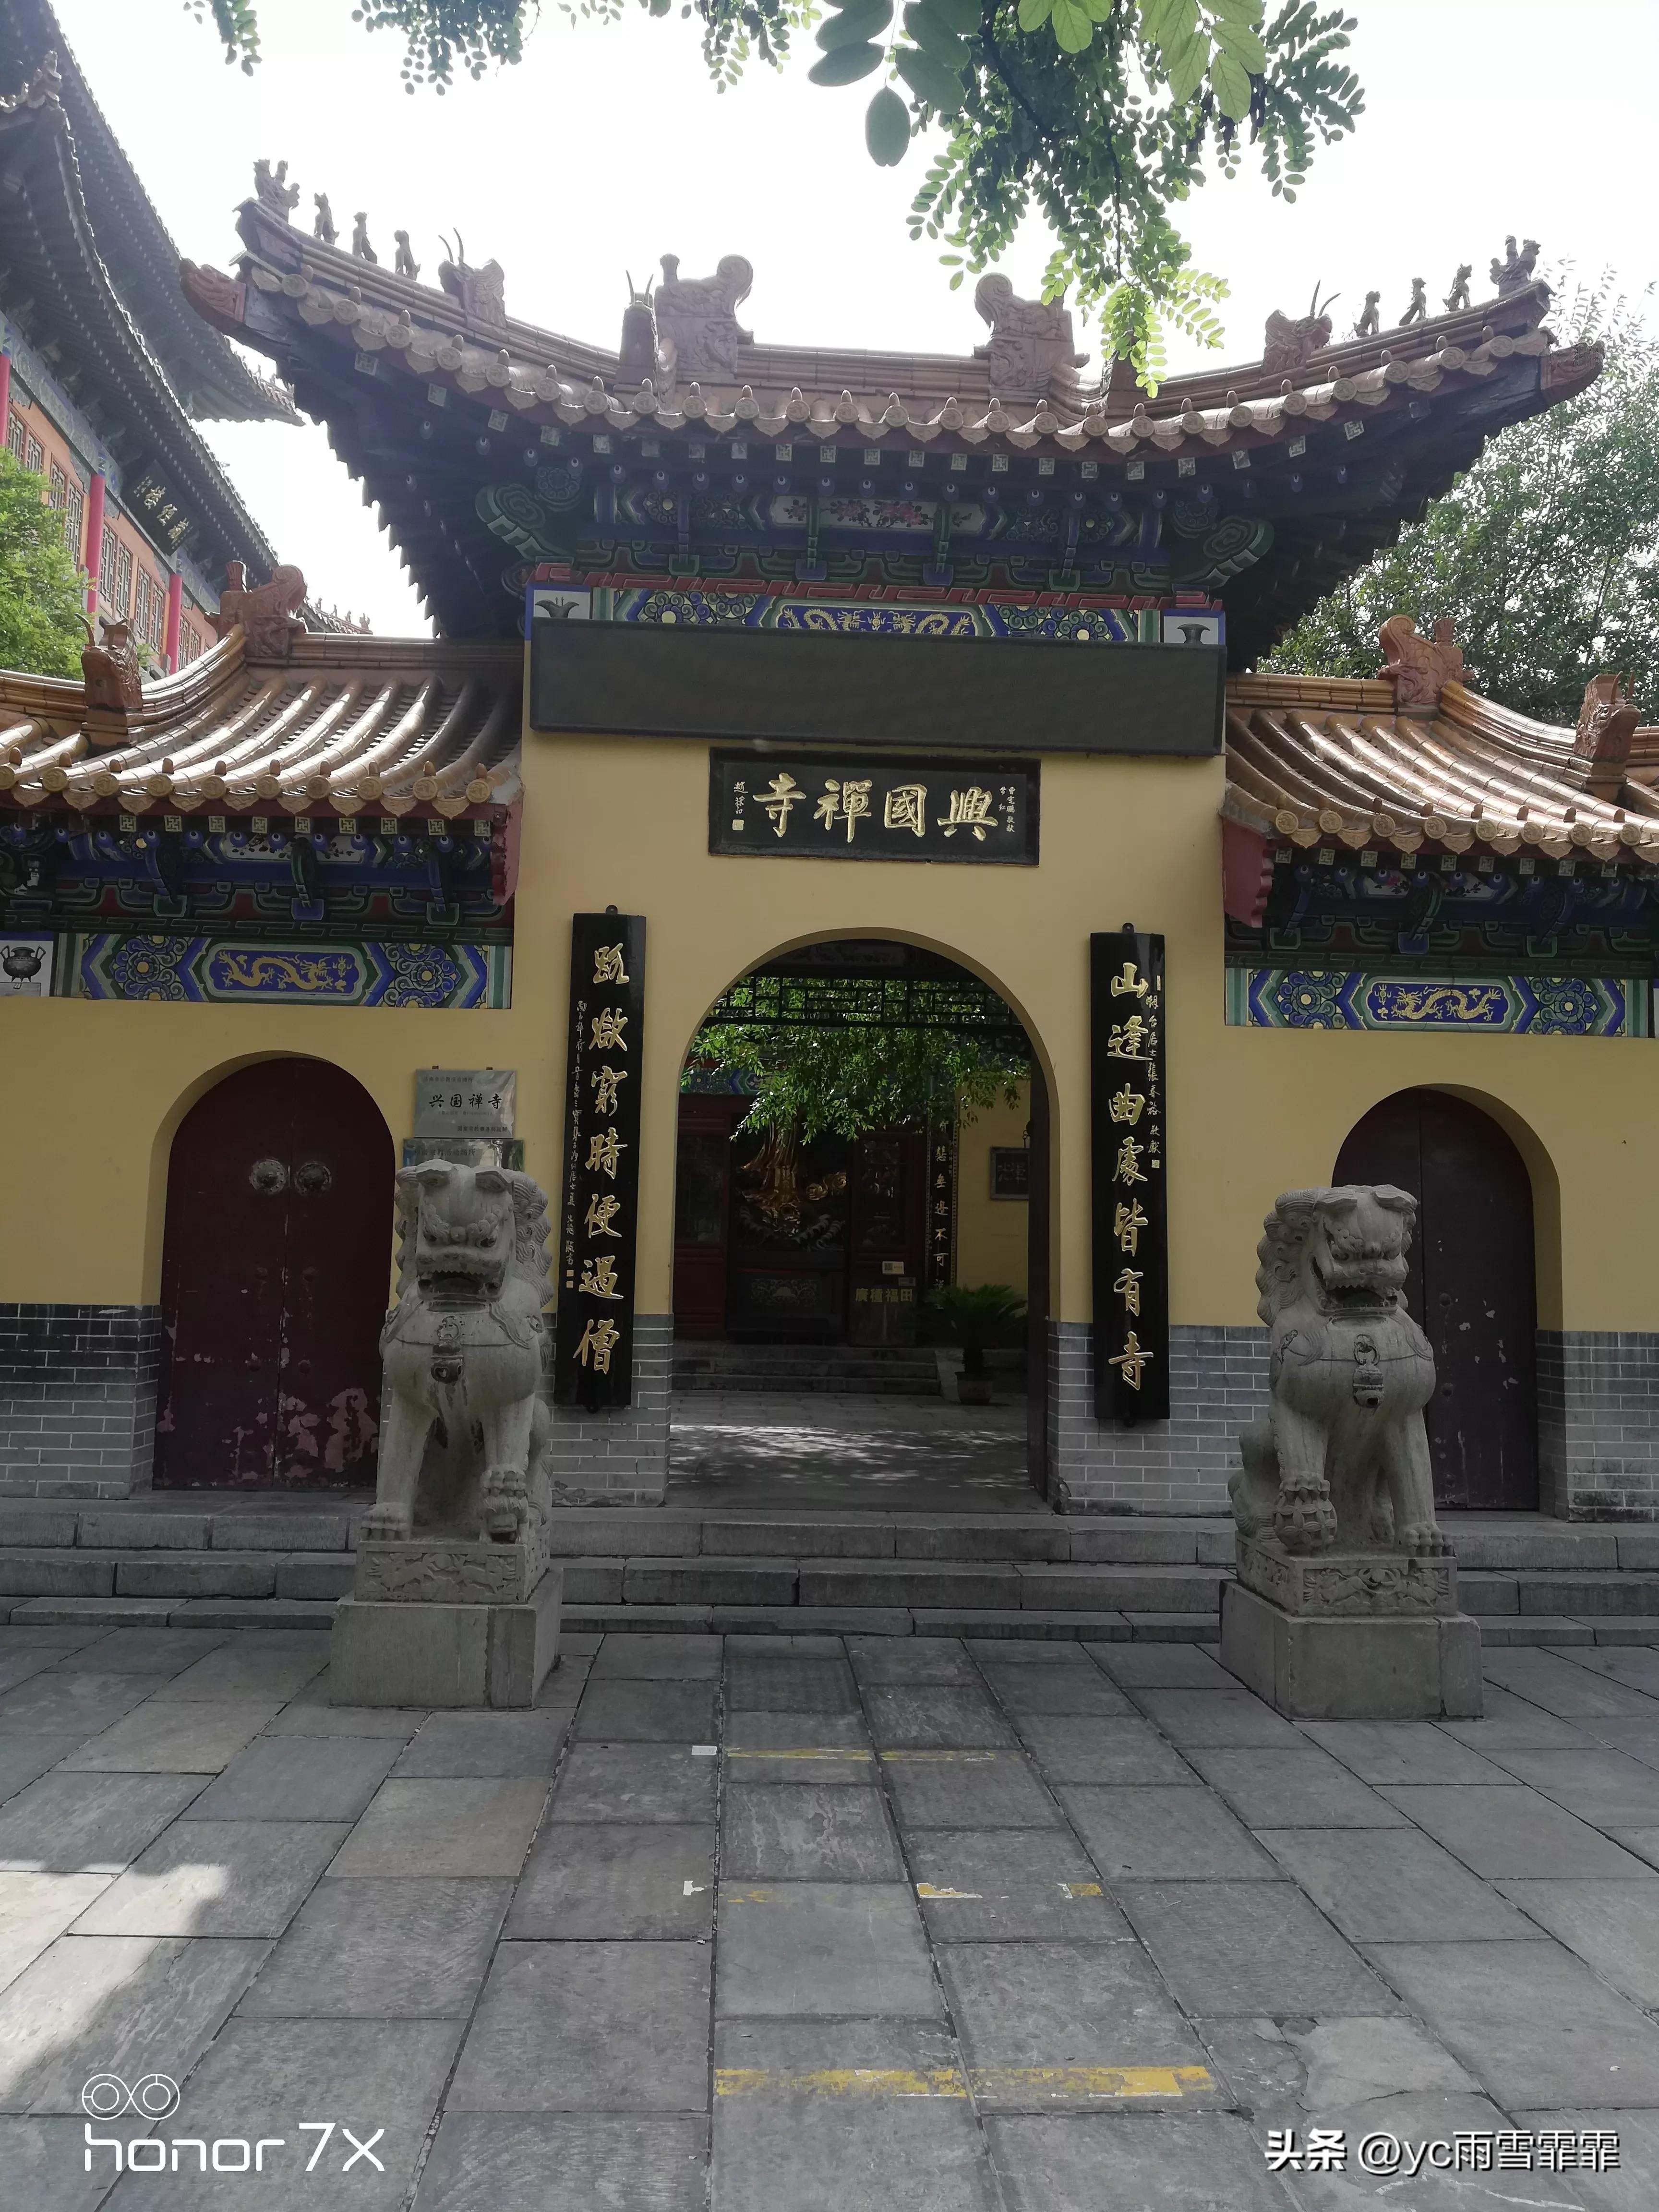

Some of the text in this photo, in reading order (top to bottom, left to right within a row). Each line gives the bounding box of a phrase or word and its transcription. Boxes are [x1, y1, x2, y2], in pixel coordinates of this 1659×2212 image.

[429, 1093, 502, 1110] 兴国禅寺
[855, 1288, 913, 1303] 廣種福田
